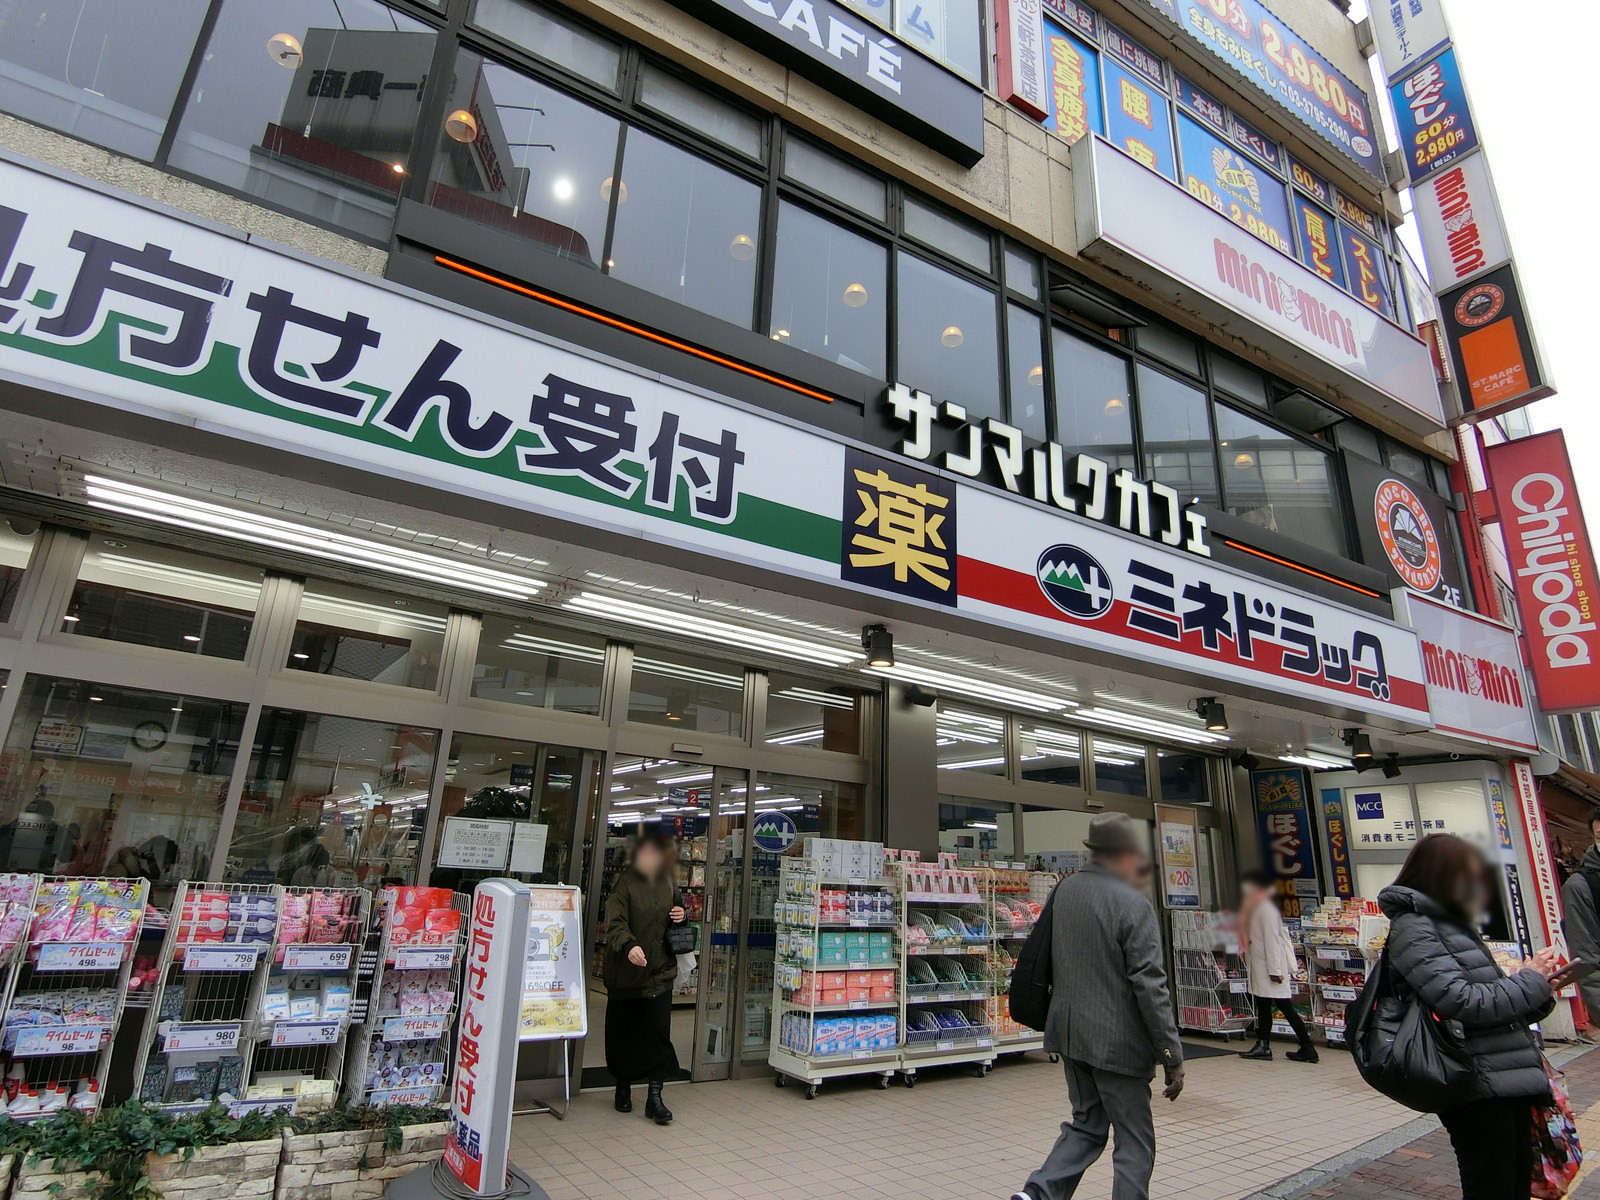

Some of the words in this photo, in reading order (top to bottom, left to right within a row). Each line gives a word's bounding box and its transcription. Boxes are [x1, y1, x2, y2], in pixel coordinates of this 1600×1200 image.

[1188, 6, 1277, 88] 全身もみほぐし
[1390, 0, 1412, 61] 費者モニタールーム
[1262, 22, 1365, 131] 2,980円
[1403, 64, 1448, 125] ほぐし
[1415, 115, 1456, 145] 60分
[1416, 129, 1465, 166] 2,980円
[1187, 177, 1225, 212] 60分
[1292, 162, 1326, 201] 60分
[1433, 167, 1471, 221] mini
[1229, 203, 1290, 255] 2,980円
[1302, 206, 1333, 280] 肩こ
[1446, 223, 1486, 278] mini
[1213, 237, 1282, 315] mini
[1297, 288, 1358, 359] mini
[1471, 363, 1523, 389] ST.MARC
[887, 381, 1211, 558] サンマルクカフェ
[848, 468, 951, 592] 薬
[1566, 543, 1578, 558] hi
[1510, 472, 1597, 669] Chiyoda
[1569, 558, 1583, 587] shoe
[1576, 590, 1592, 620] shop
[1126, 558, 1391, 701] ミネドラッグ
[1420, 639, 1469, 695] mini
[1476, 658, 1524, 709] mini
[690, 793, 697, 803] 2
[1356, 801, 1383, 812] MCC
[1328, 819, 1345, 862] ほぐし
[1393, 819, 1446, 830] 三軒茶屋
[1266, 813, 1302, 875] ほぐし
[68, 946, 117, 957] タイムセール
[78, 959, 97, 967] 498
[234, 954, 253, 963] 798
[329, 952, 347, 961] 699
[434, 953, 450, 962] 298
[453, 890, 495, 1117] 処方せん受付
[45, 1029, 95, 1042] タイムセール
[215, 1030, 236, 1041] 980
[320, 1027, 335, 1036] 152
[403, 1019, 439, 1030] タイムセール
[61, 1042, 74, 1052] 98
[389, 1091, 427, 1102] タイムセール
